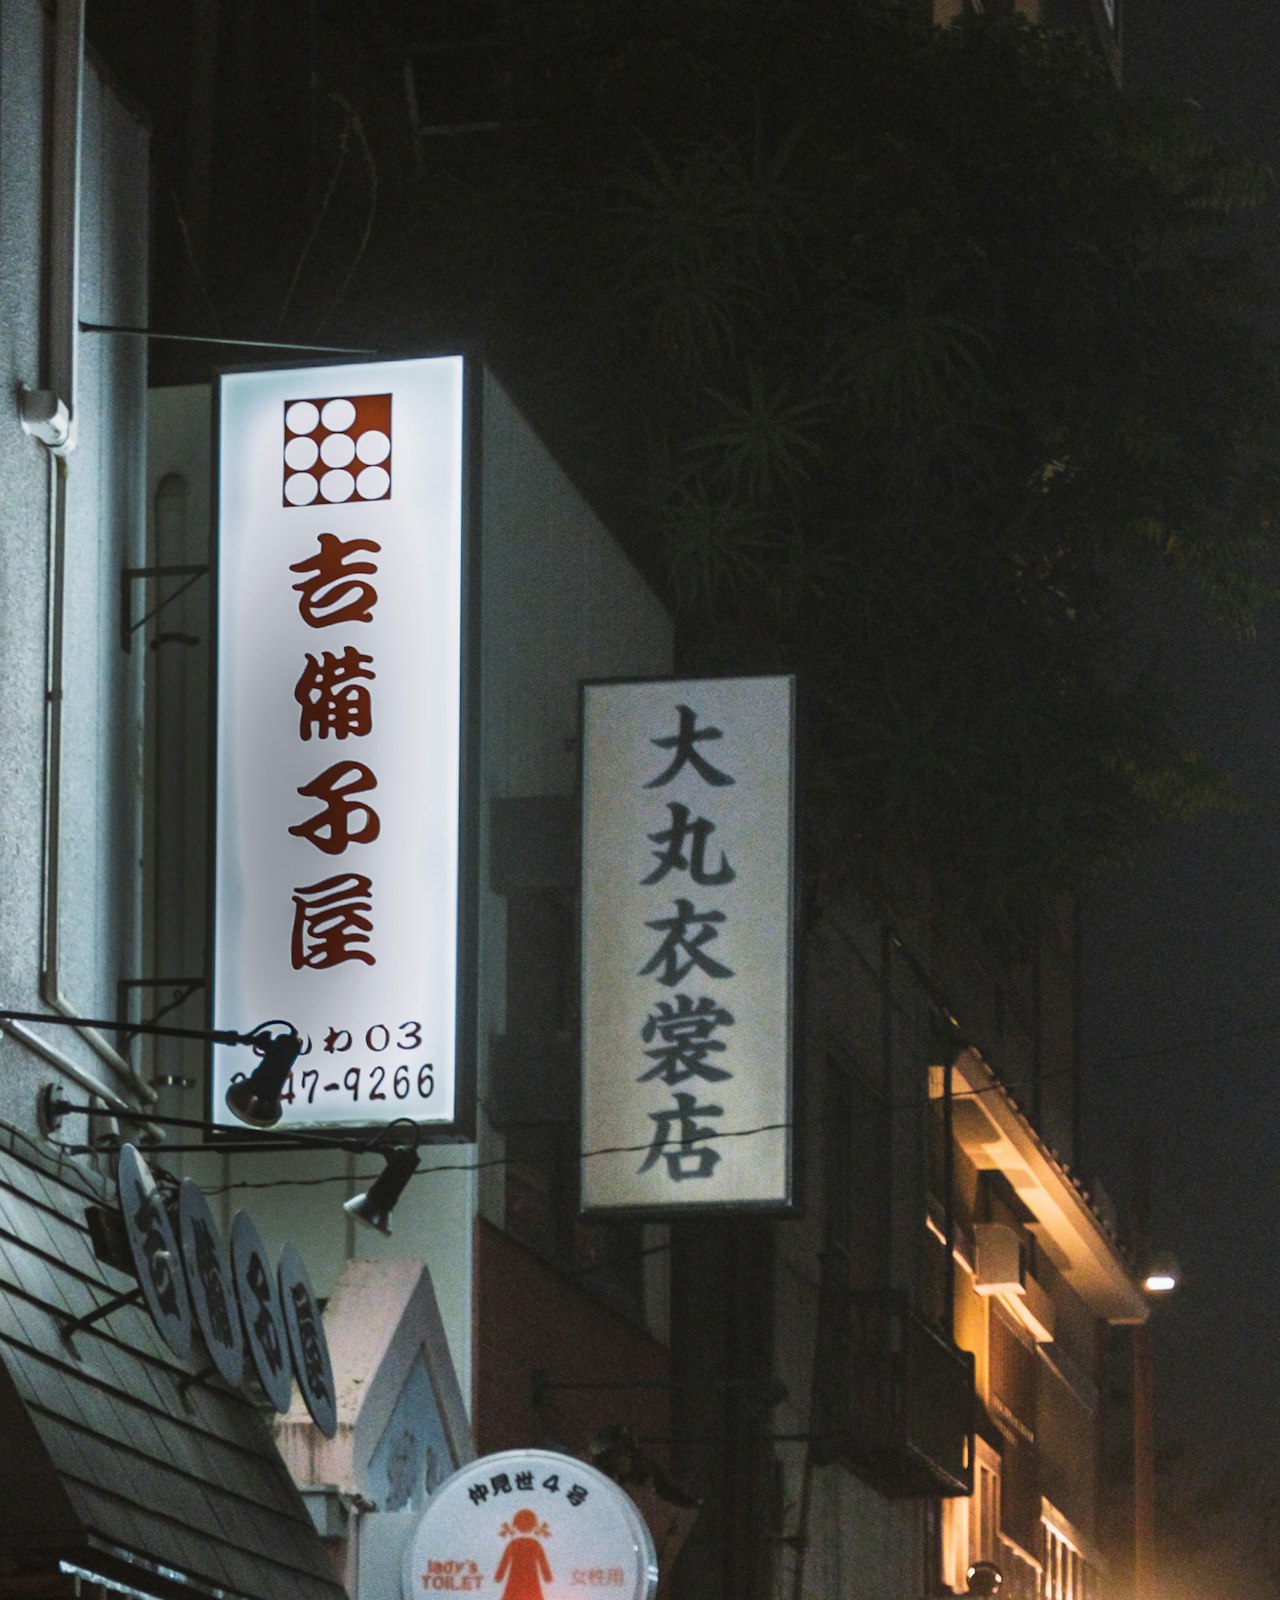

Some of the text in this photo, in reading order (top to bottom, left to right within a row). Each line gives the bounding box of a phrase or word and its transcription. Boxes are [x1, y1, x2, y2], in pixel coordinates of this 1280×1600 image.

[288, 532, 382, 971] 吉備子屋
[639, 704, 737, 1183] 大丸衣裳店
[421, 1575, 484, 1591] TOILET
